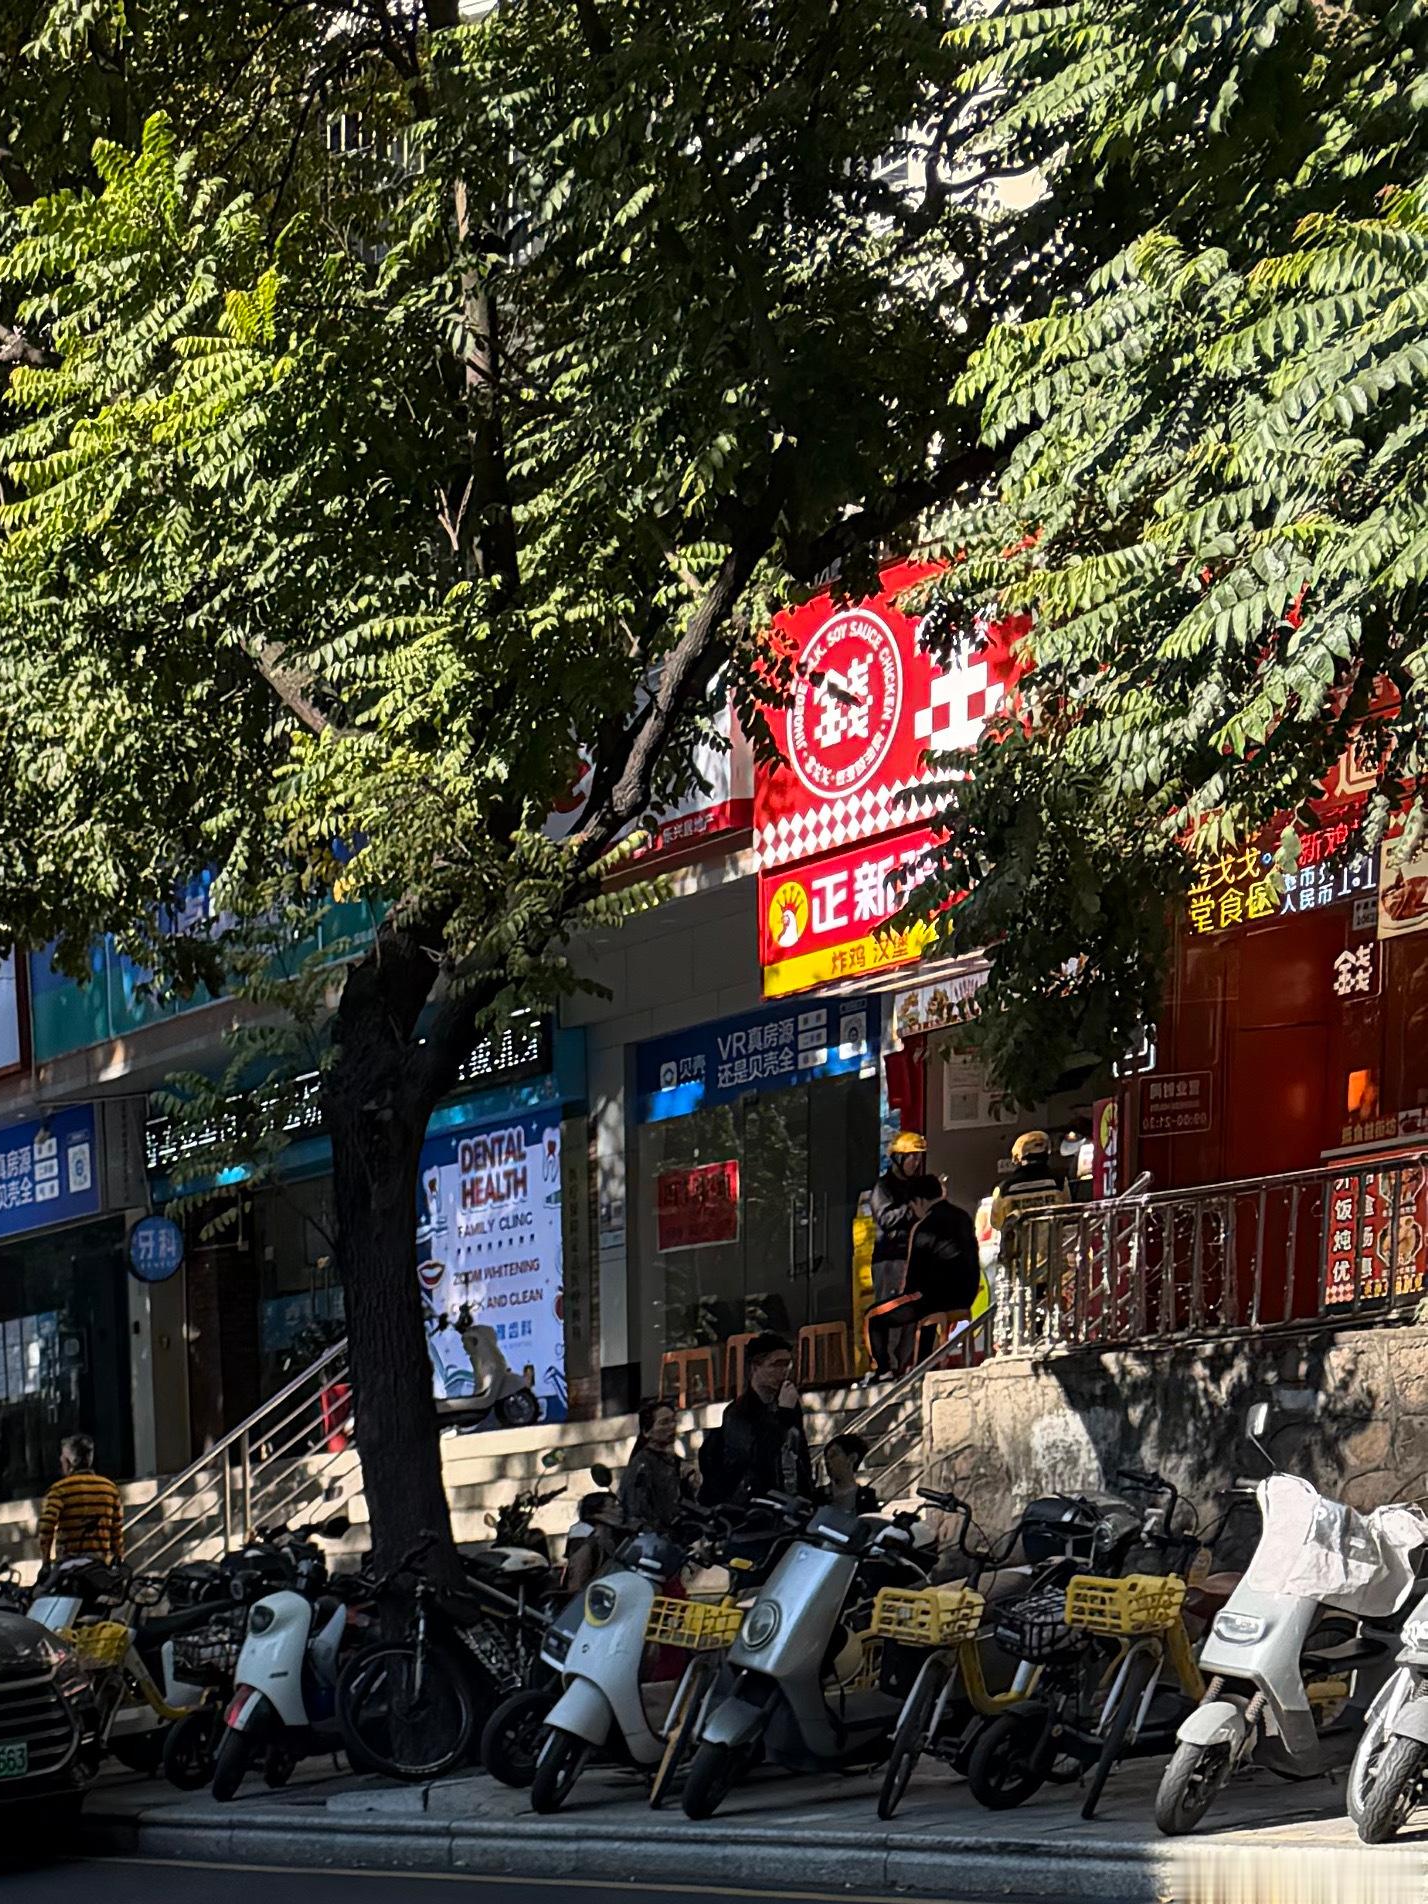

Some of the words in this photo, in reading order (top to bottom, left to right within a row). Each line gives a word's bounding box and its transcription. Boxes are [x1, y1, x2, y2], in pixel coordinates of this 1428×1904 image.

[849, 620, 884, 652] SAUCE
[1280, 883, 1334, 916] 人民币
[831, 945, 867, 975] 炸鸡
[717, 1017, 795, 1062] VR真房源
[717, 1047, 796, 1090] 还是贝壳全
[461, 1129, 527, 1174] DENTAL
[461, 1166, 529, 1210] HEALTH
[457, 1217, 495, 1238] FAMILY
[499, 1212, 534, 1232] CLINIC
[139, 1228, 177, 1261] 牙科
[453, 1265, 483, 1286] ZOOM
[484, 1257, 541, 1280] WHITENING
[487, 1294, 507, 1309] AND
[509, 1288, 544, 1308] CLEAN
